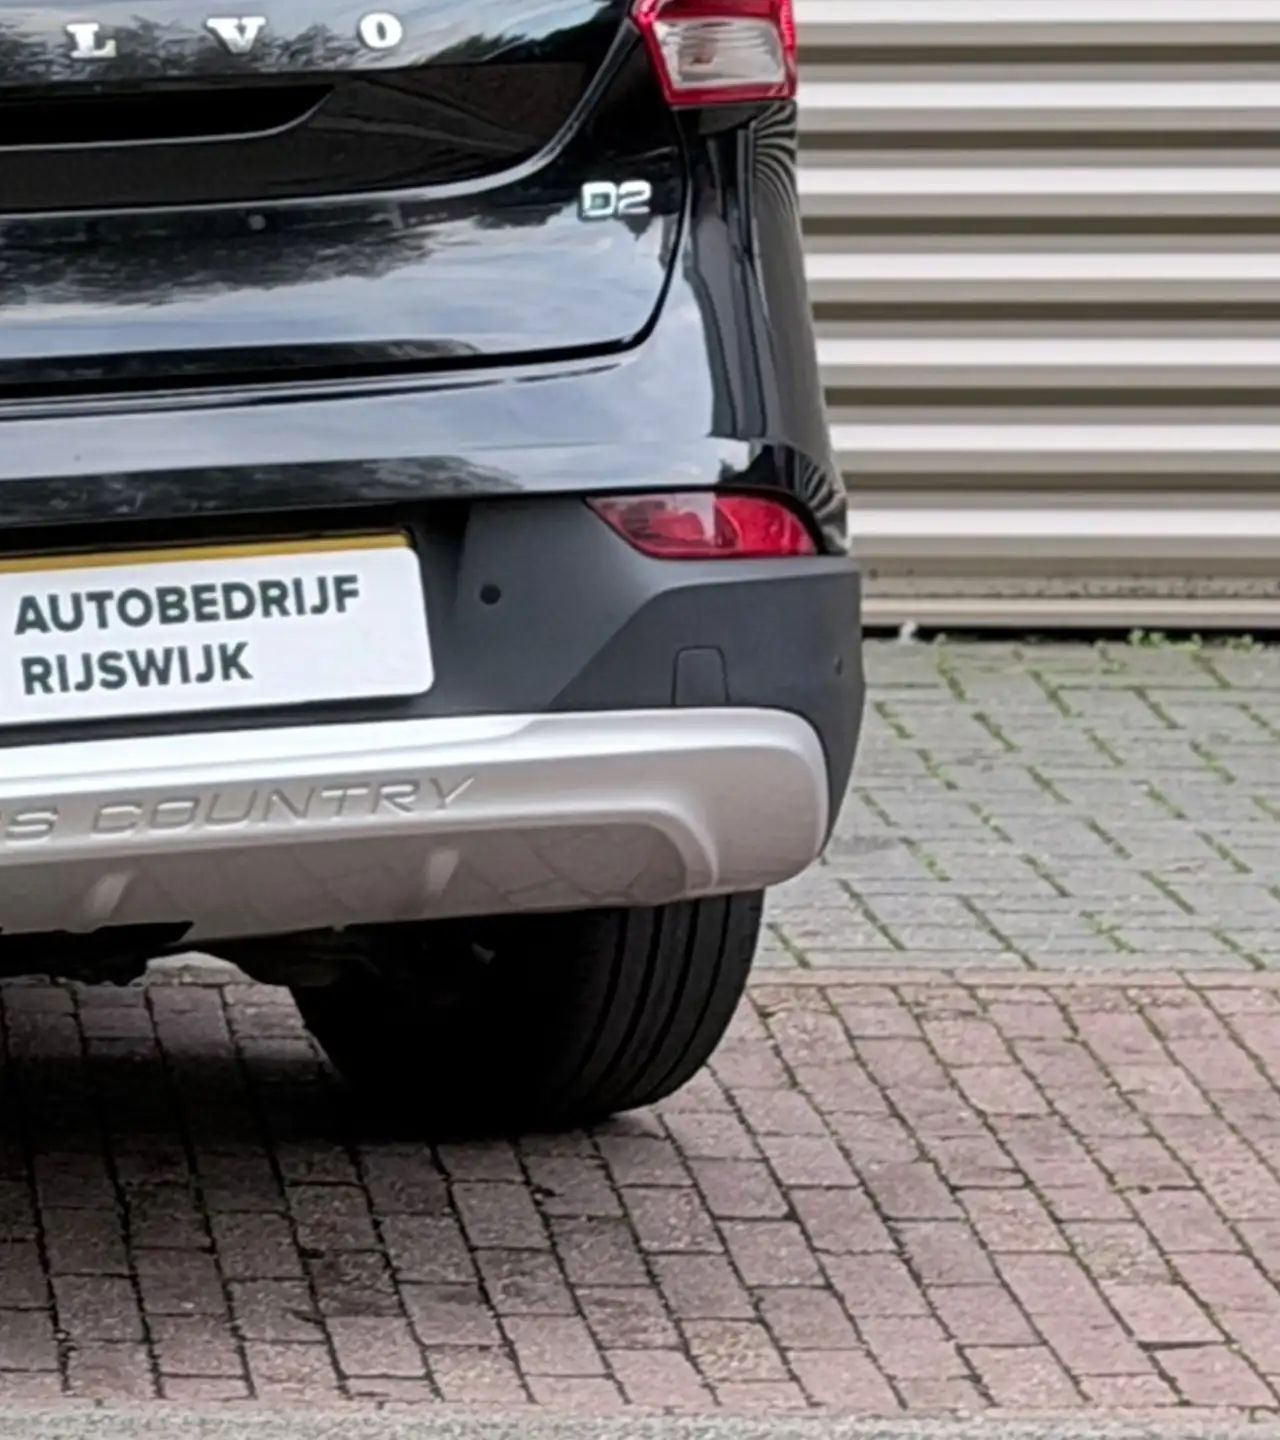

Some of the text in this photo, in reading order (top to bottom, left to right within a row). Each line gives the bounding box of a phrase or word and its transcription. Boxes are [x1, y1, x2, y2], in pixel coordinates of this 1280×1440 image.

[579, 181, 652, 220] D2
[14, 574, 361, 636] AUTOBEDRIJF
[21, 641, 253, 696] RIJSWIJK
[91, 776, 476, 836] COUNTRY
